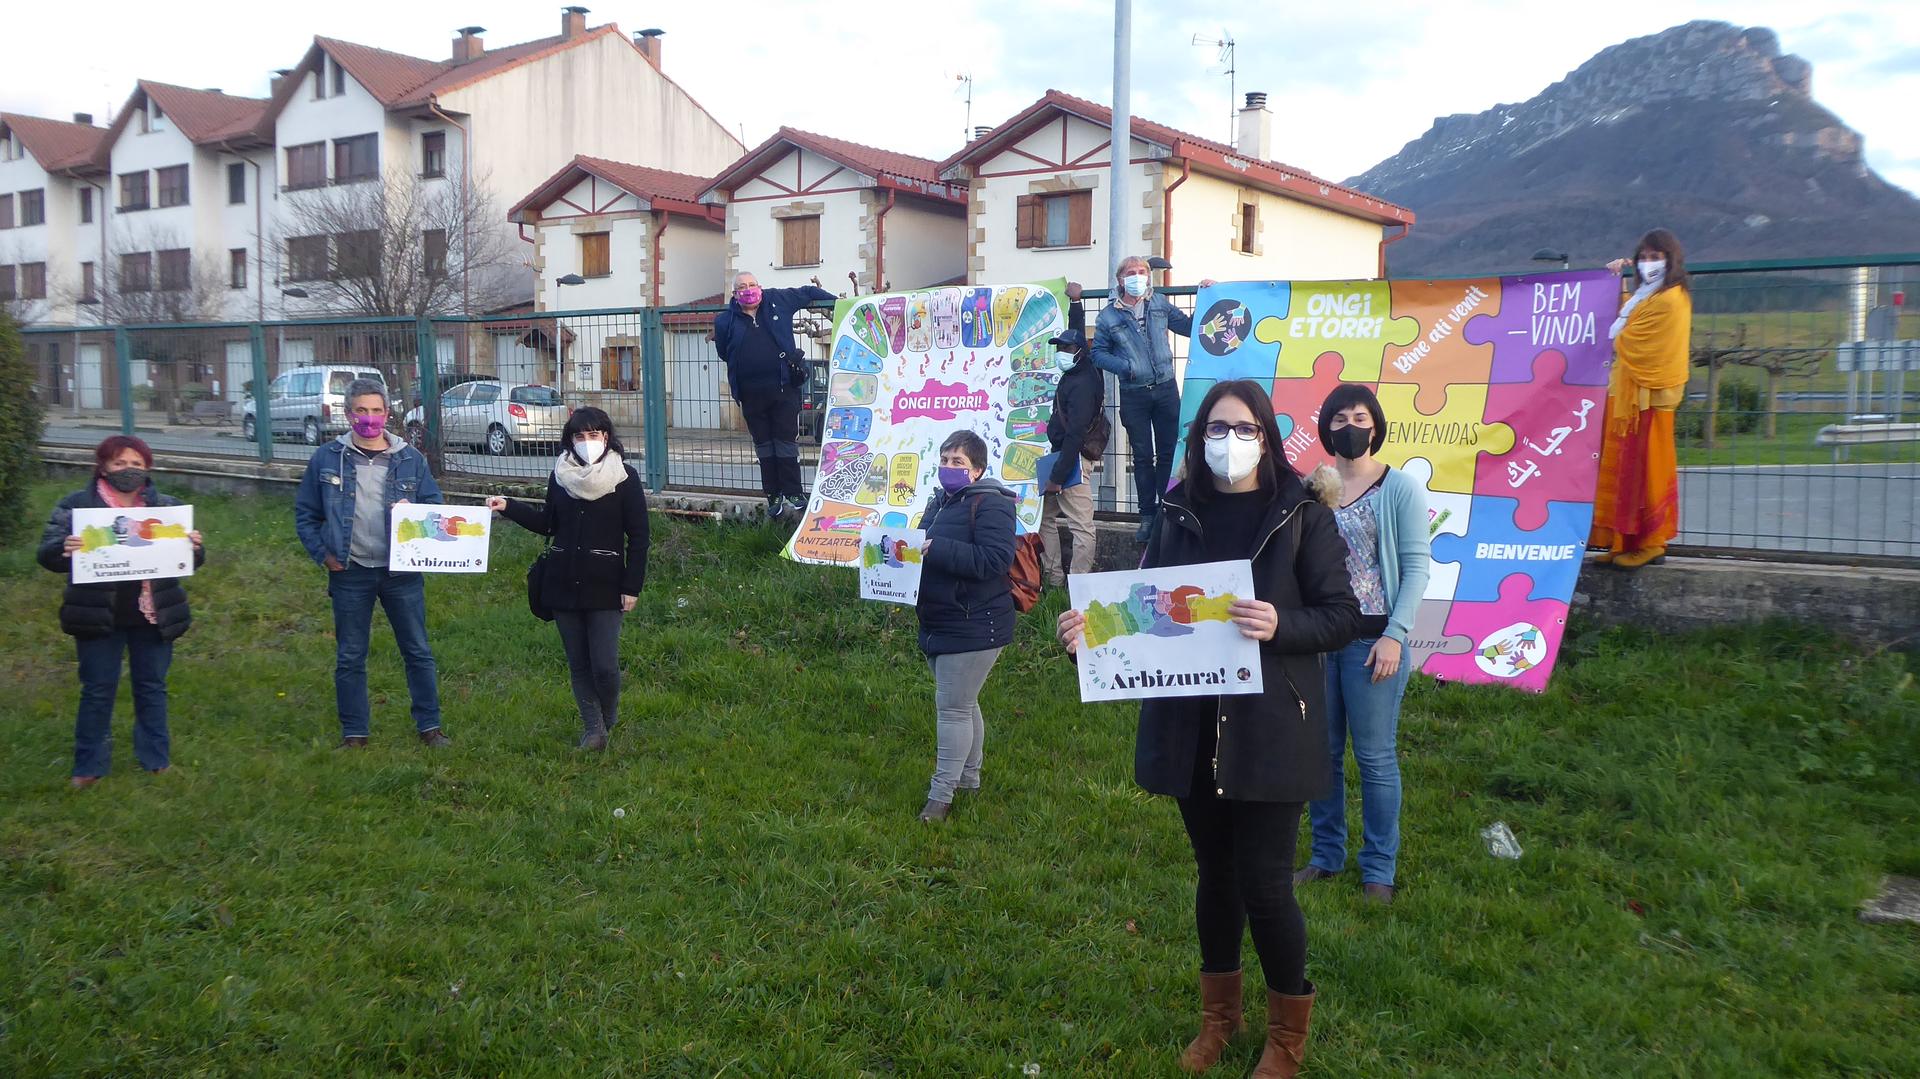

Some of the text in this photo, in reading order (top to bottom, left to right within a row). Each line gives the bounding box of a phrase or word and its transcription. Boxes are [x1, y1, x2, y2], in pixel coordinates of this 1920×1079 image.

[1533, 281, 1581, 314] BEM
[1392, 340, 1430, 374] Bine
[1447, 285, 1489, 322] venit
[898, 395, 983, 410] ONGI ETORRI!
[1386, 421, 1480, 446] ENVENIDAS
[407, 557, 470, 568] Arbizura!
[1475, 542, 1576, 561] BIENVENUE
[1110, 667, 1226, 690] Arbizura!
